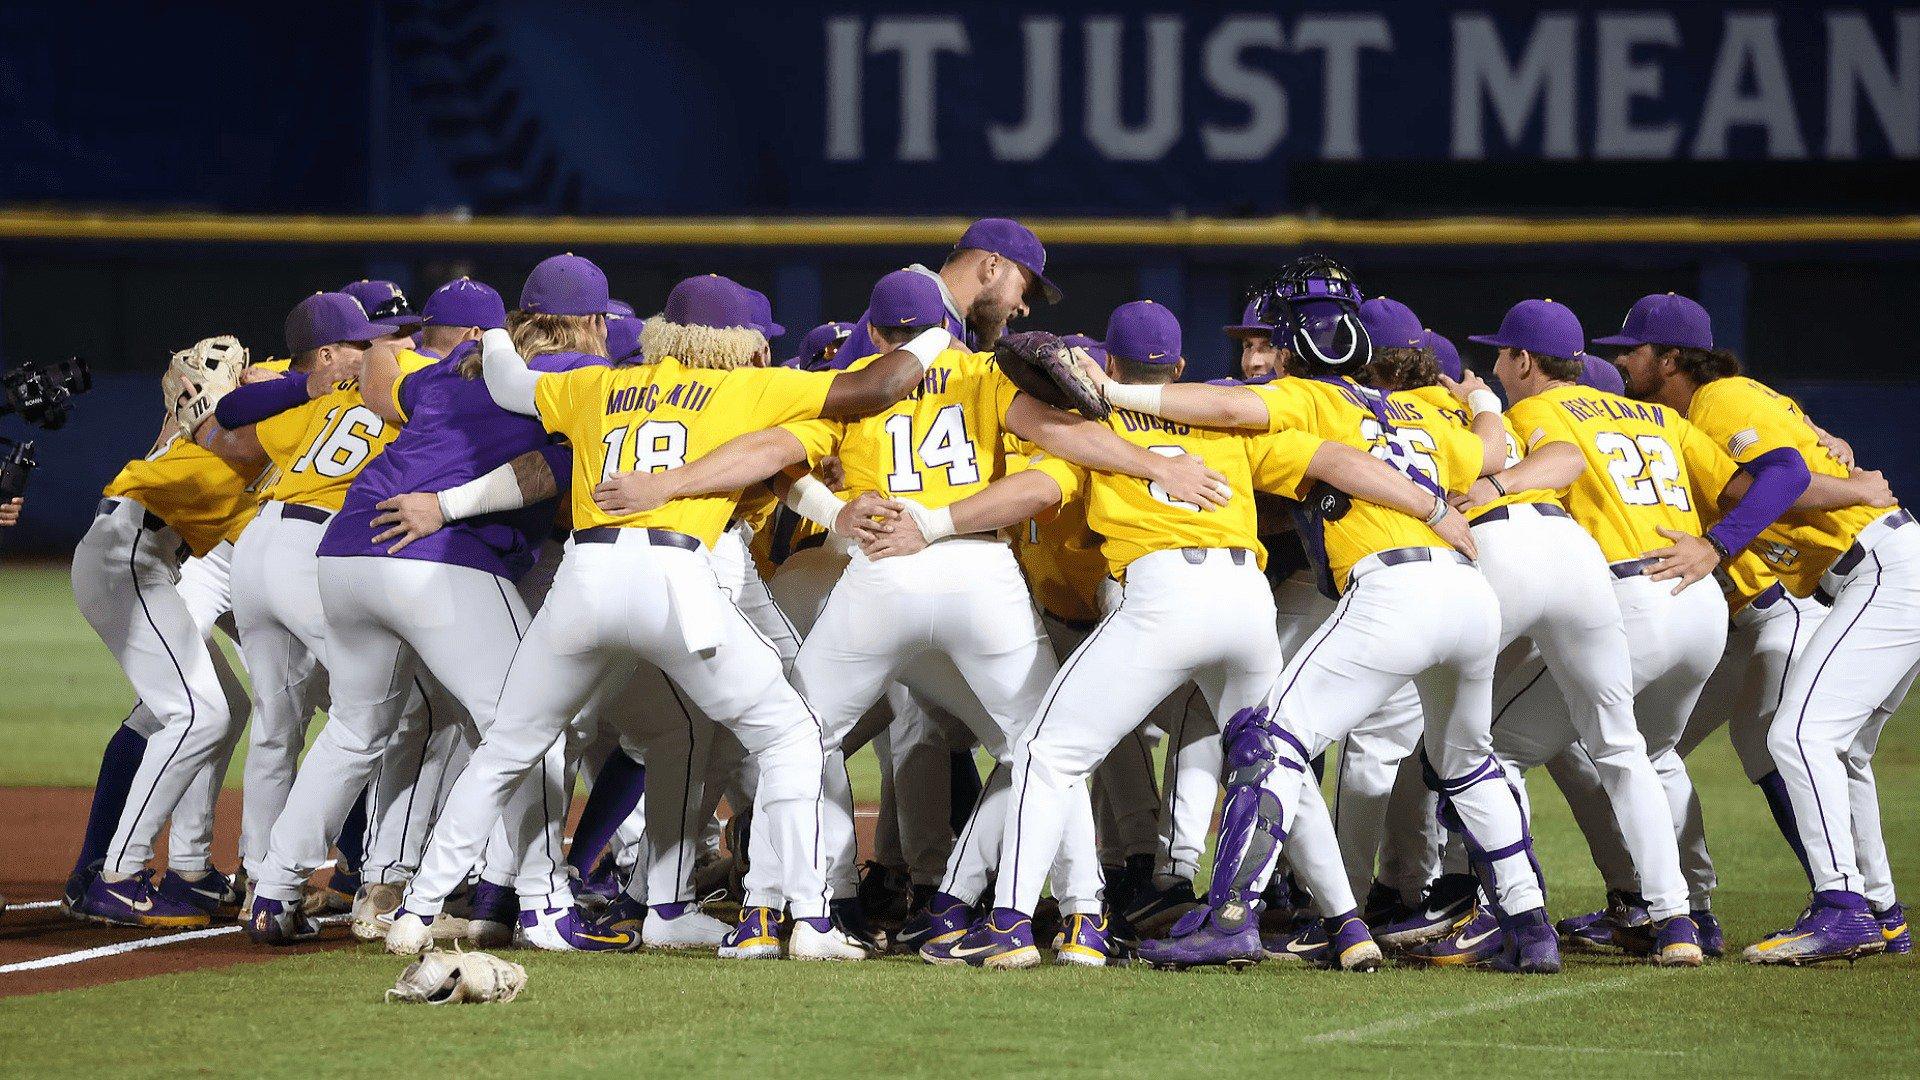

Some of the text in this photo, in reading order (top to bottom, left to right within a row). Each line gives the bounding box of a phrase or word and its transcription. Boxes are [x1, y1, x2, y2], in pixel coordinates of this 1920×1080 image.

[825, 14, 1920, 161] IT JUST MEAN
[291, 404, 386, 478] 16
[600, 420, 688, 484] 18
[885, 403, 981, 493] 14
[1595, 431, 1692, 512] 22
